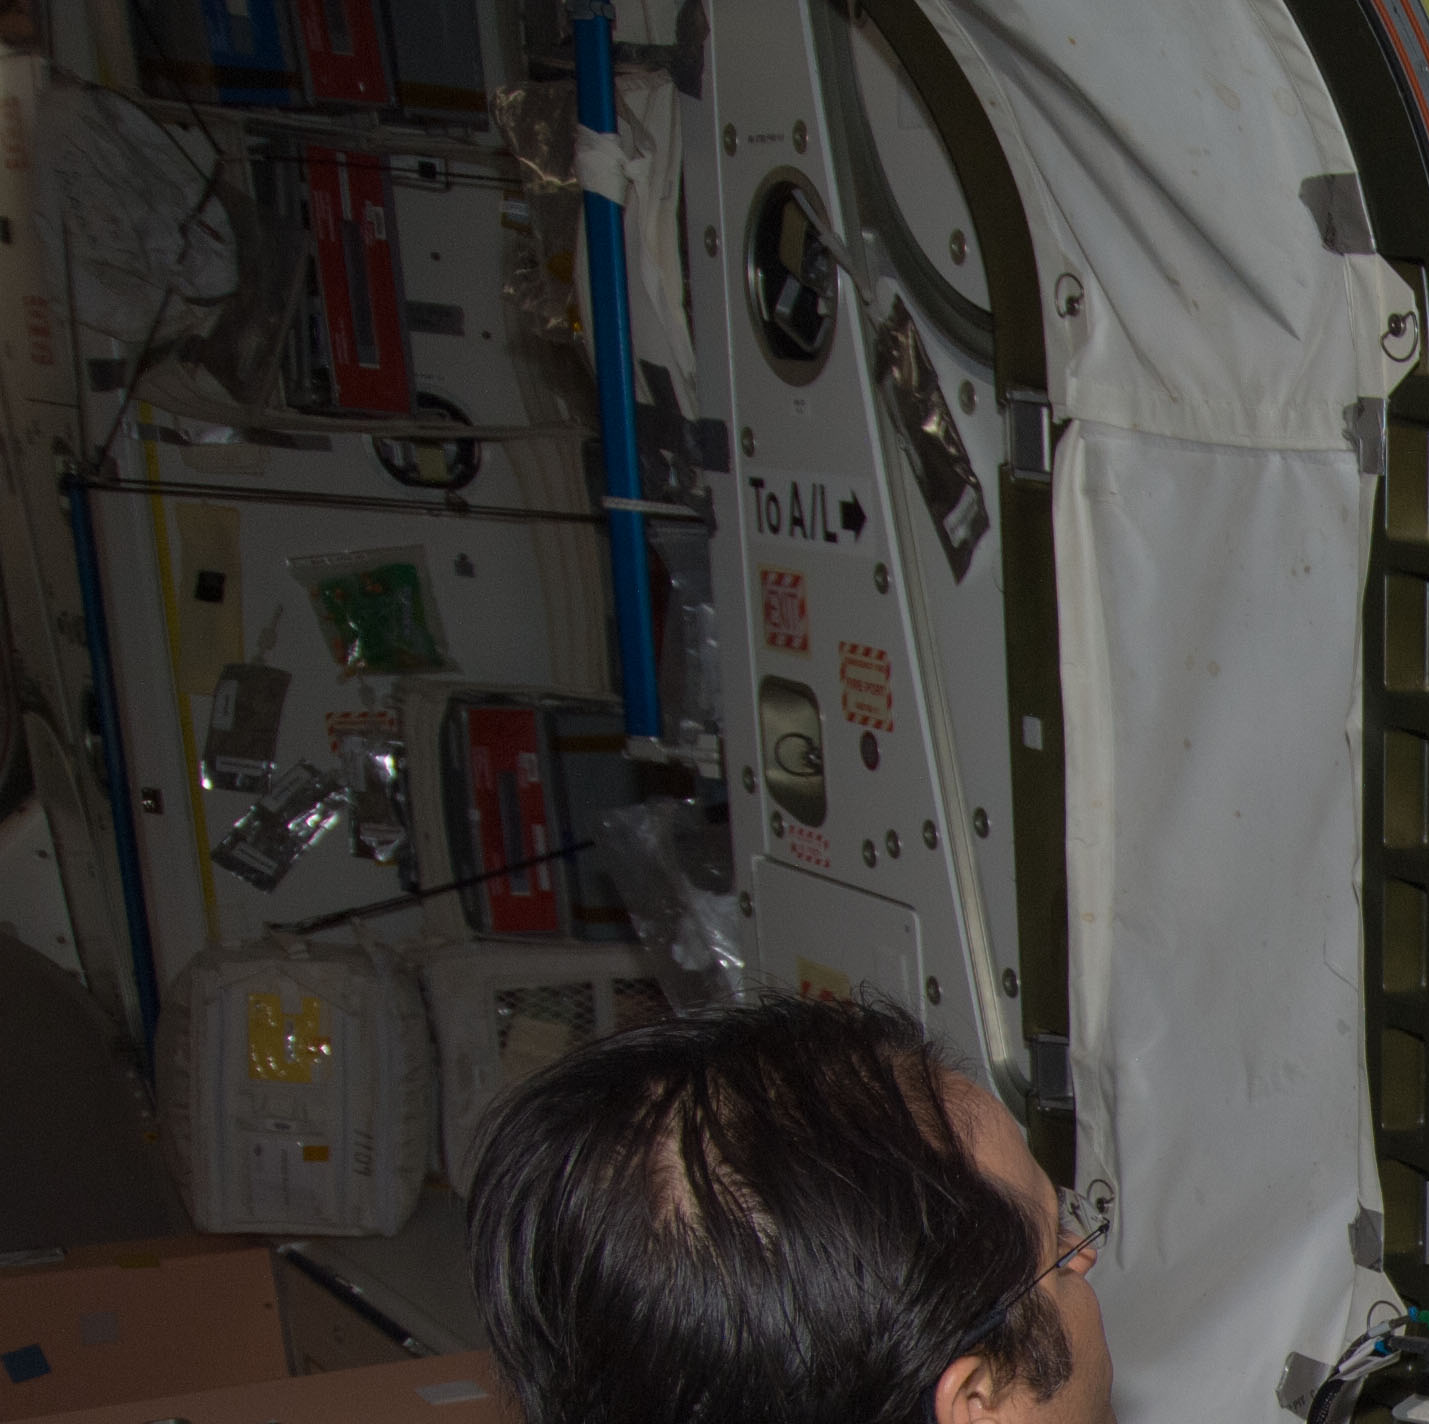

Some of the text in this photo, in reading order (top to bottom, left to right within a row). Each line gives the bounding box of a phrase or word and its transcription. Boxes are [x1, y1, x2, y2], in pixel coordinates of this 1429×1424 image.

[749, 477, 838, 543] To A/L
[766, 590, 797, 629] EXIT
